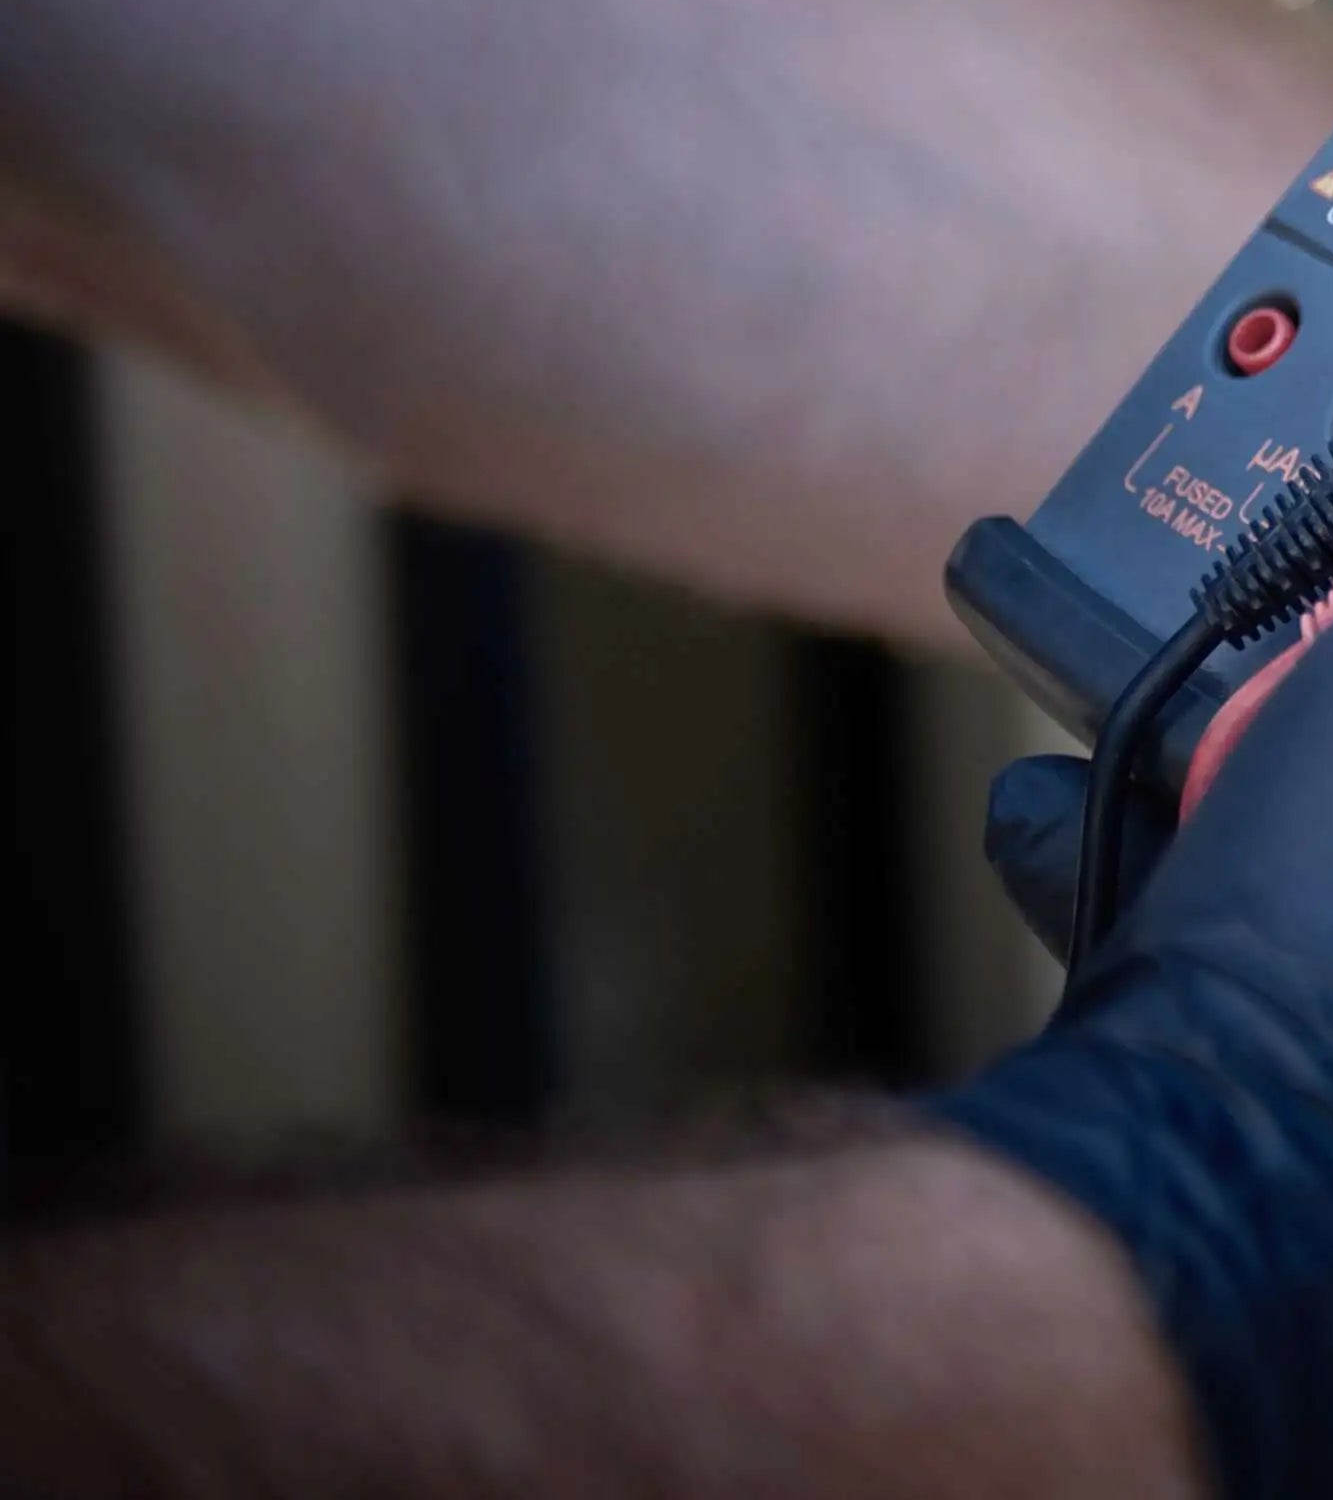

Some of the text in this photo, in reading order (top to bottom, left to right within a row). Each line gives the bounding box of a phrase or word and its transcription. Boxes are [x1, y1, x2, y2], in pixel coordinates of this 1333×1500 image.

[1171, 384, 1203, 421] A
[1139, 487, 1177, 524] 10A
[1163, 465, 1234, 520] FUSED
